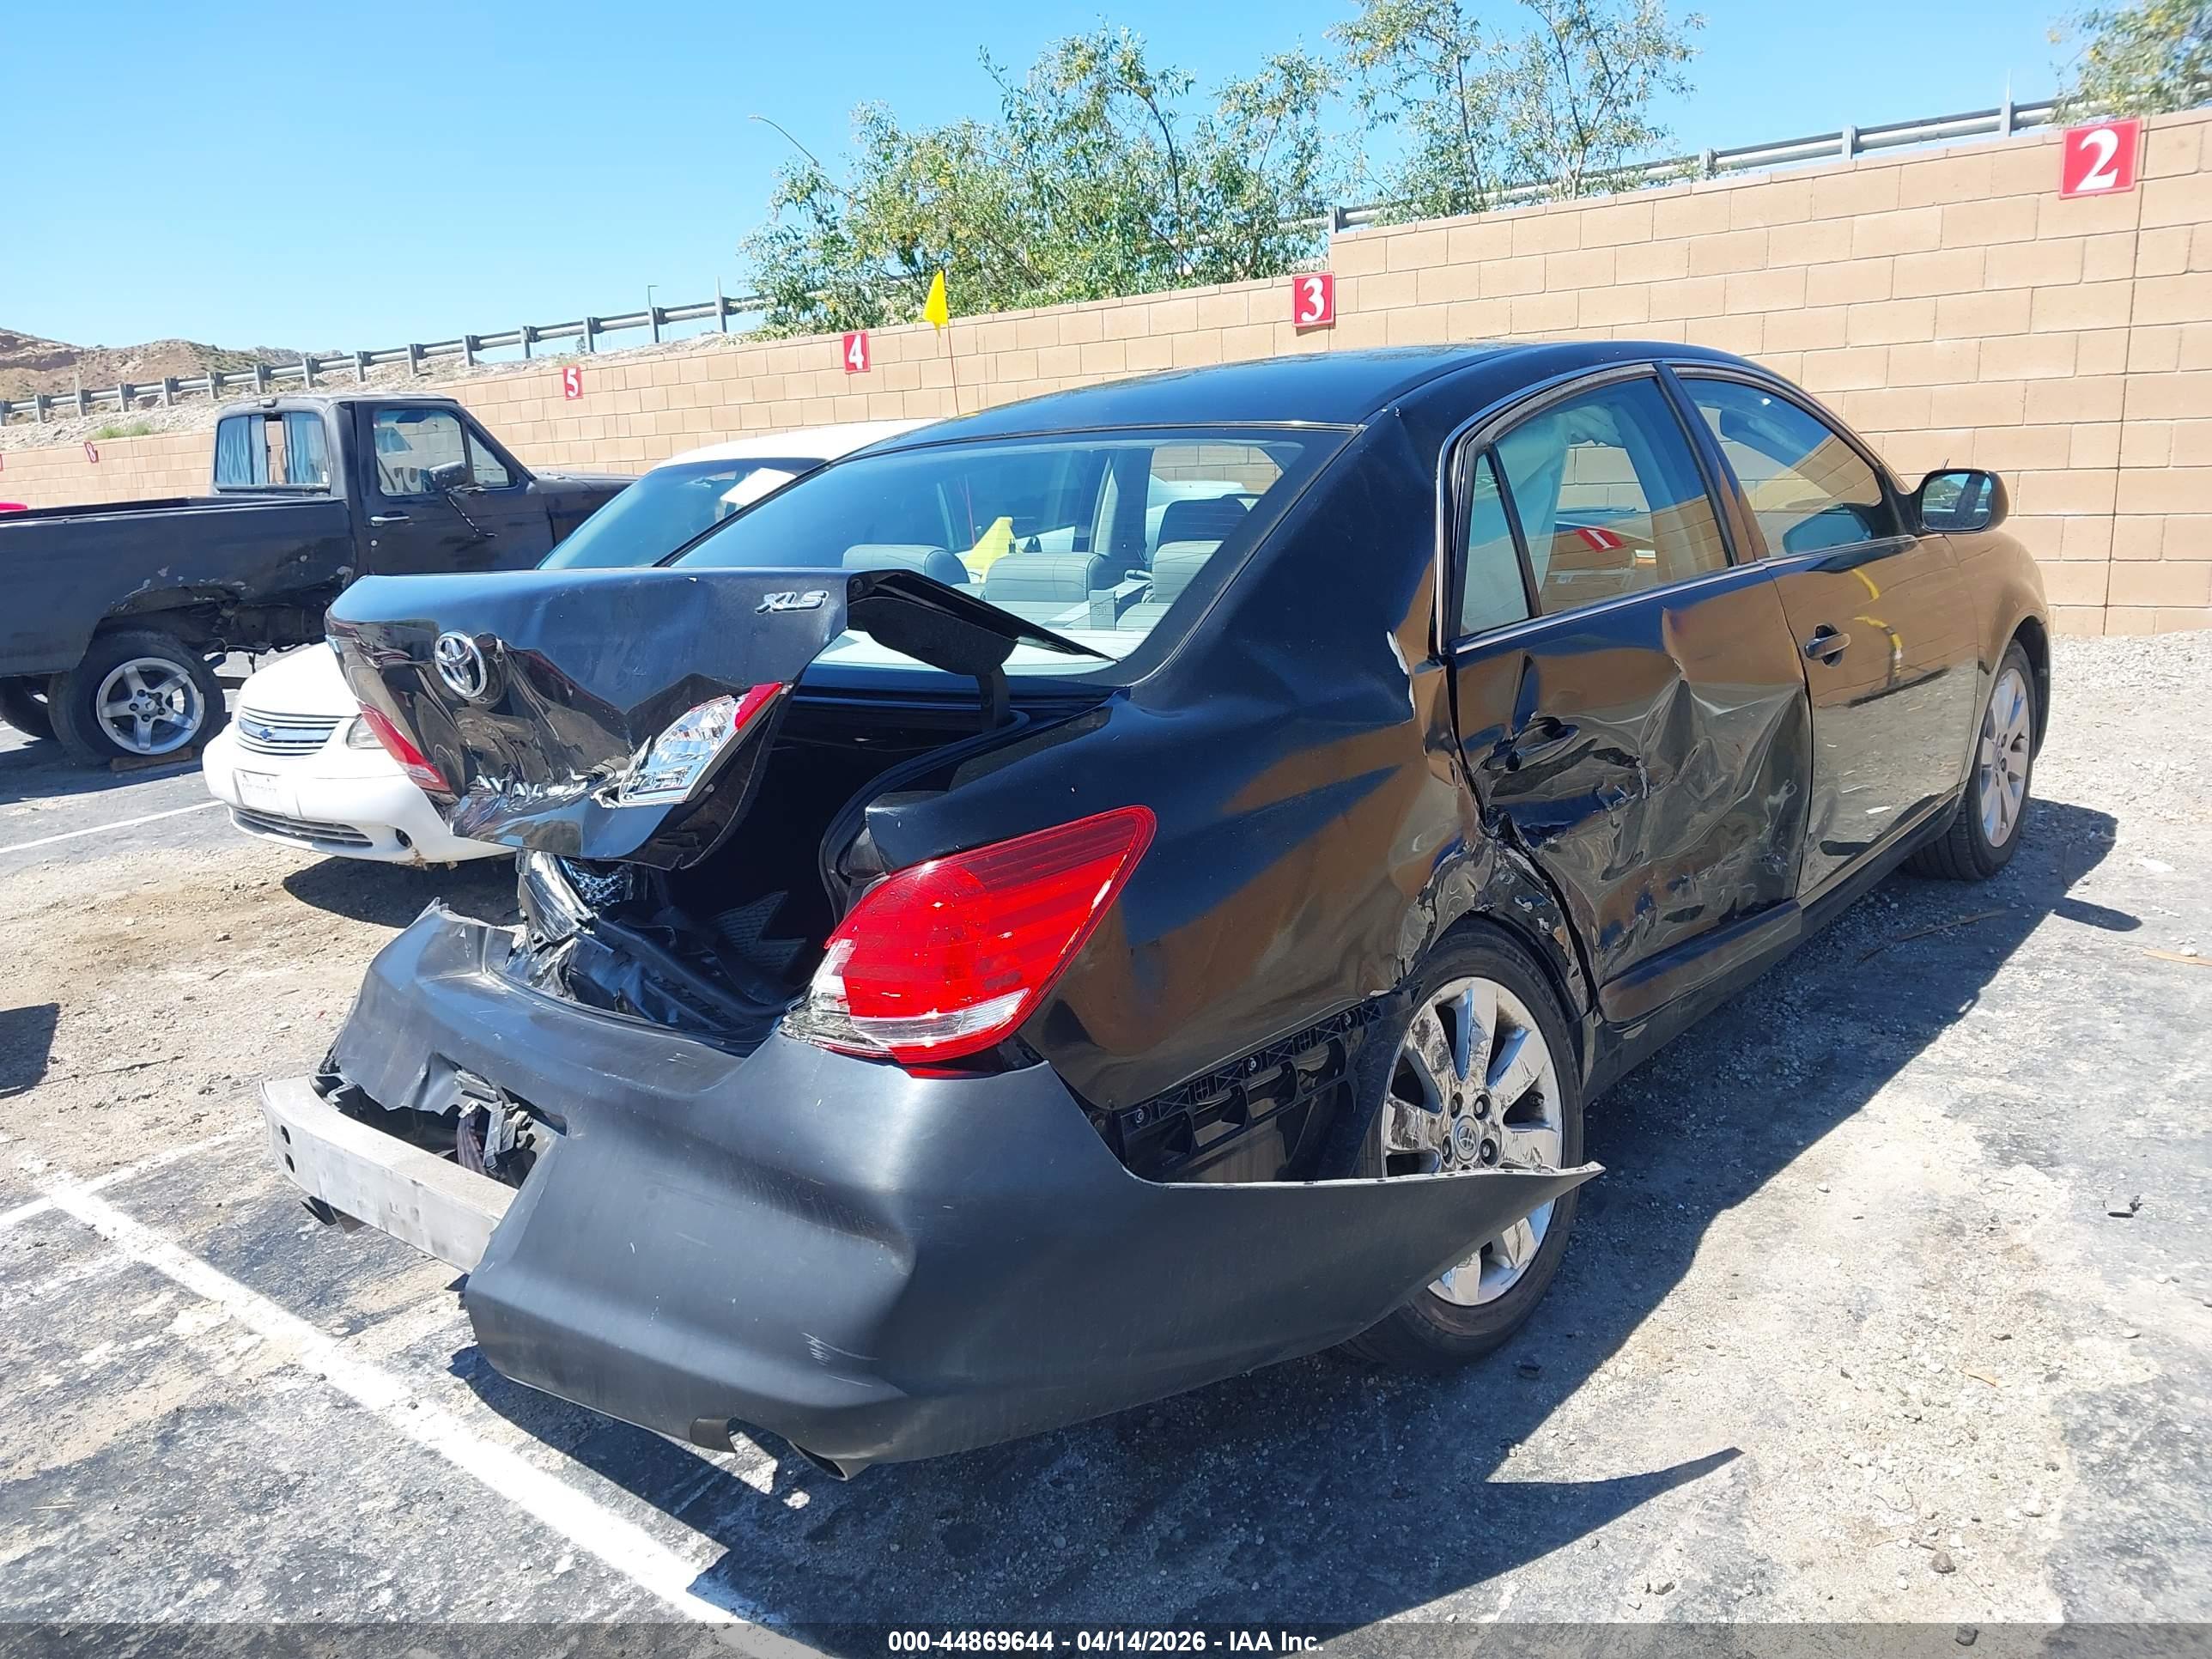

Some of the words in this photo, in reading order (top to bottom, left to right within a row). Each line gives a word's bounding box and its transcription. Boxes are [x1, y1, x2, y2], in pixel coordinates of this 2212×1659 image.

[2075, 128, 2118, 191] 2
[1301, 276, 1325, 322] 3
[848, 334, 865, 370] 4
[566, 368, 579, 397] 5
[86, 442, 96, 462] 8
[756, 590, 830, 615] XLS
